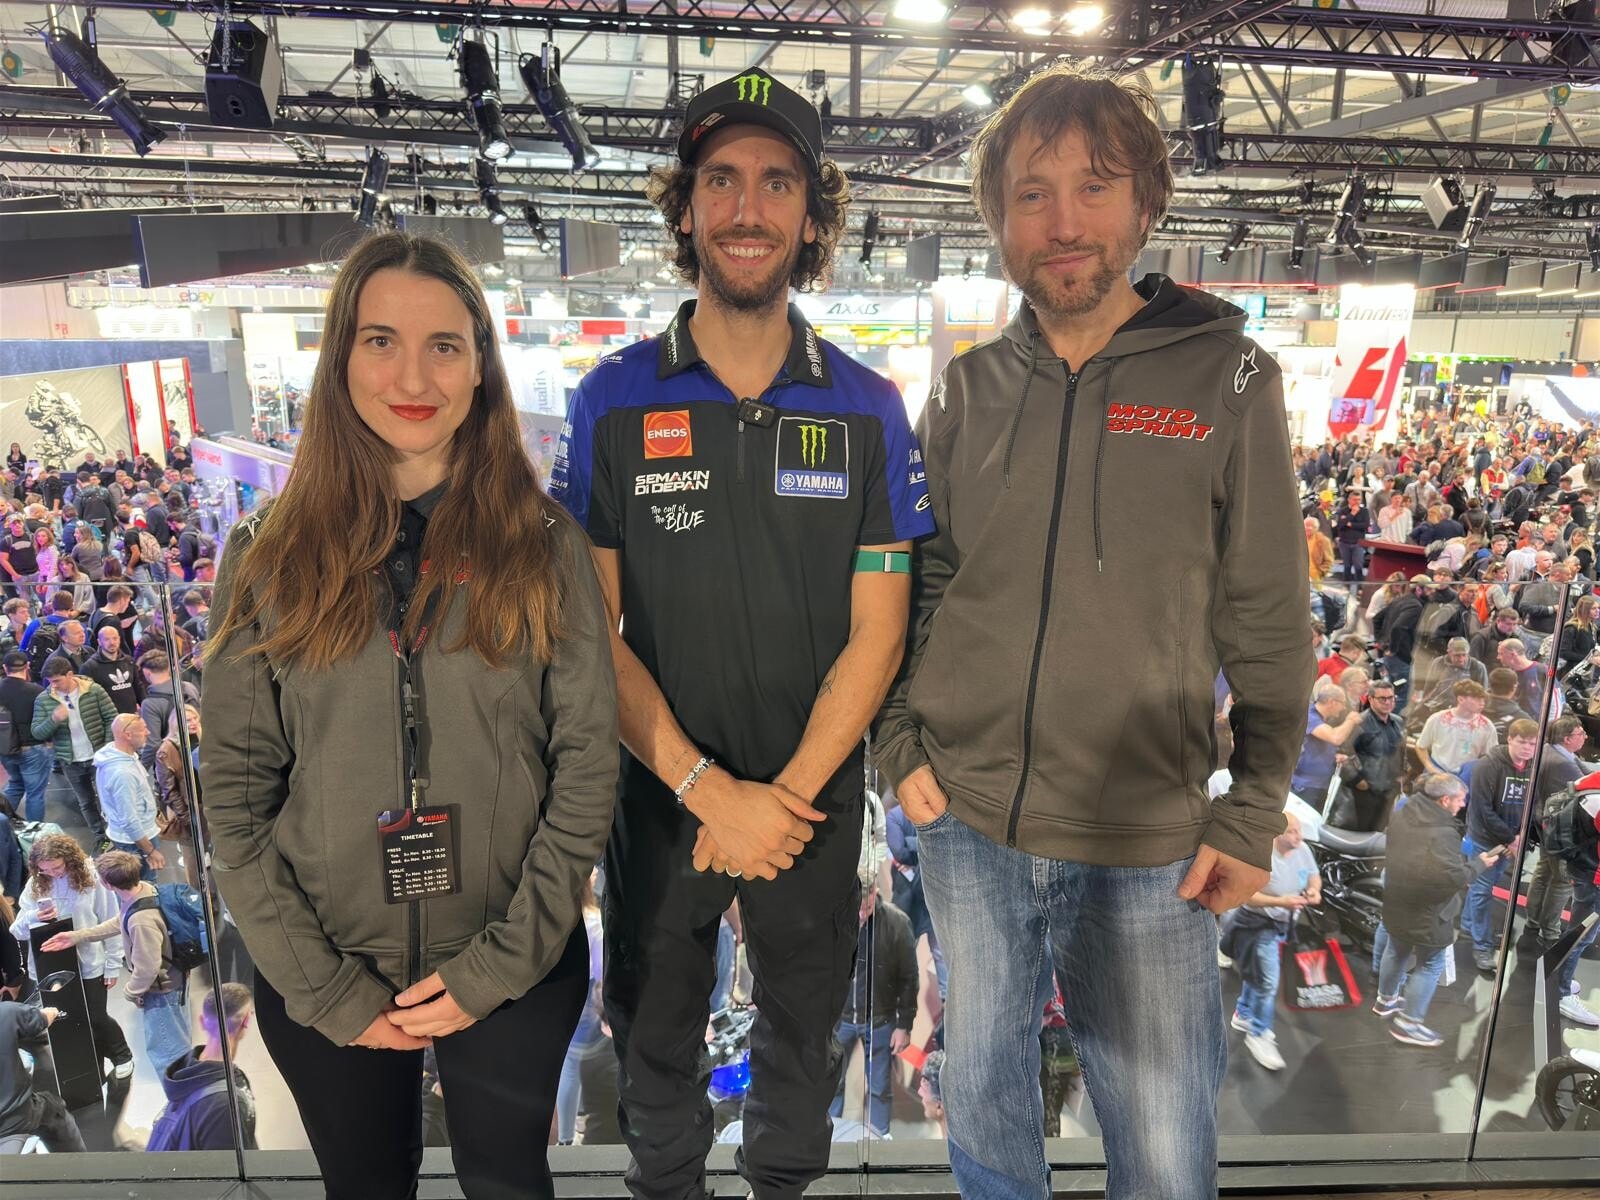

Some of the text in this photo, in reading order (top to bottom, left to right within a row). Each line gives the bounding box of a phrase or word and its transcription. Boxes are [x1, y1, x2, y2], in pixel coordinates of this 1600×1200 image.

[179, 290, 214, 304] ebay
[805, 326, 820, 364] YAMAHA
[1108, 403, 1197, 424] MOTO
[647, 428, 688, 440] ENEOS
[1106, 418, 1214, 442] SPRINT
[651, 480, 709, 494] DEPAN
[795, 474, 844, 490] YAMAHA
[664, 510, 706, 532] BLUE
[425, 814, 448, 822] YAMAHA
